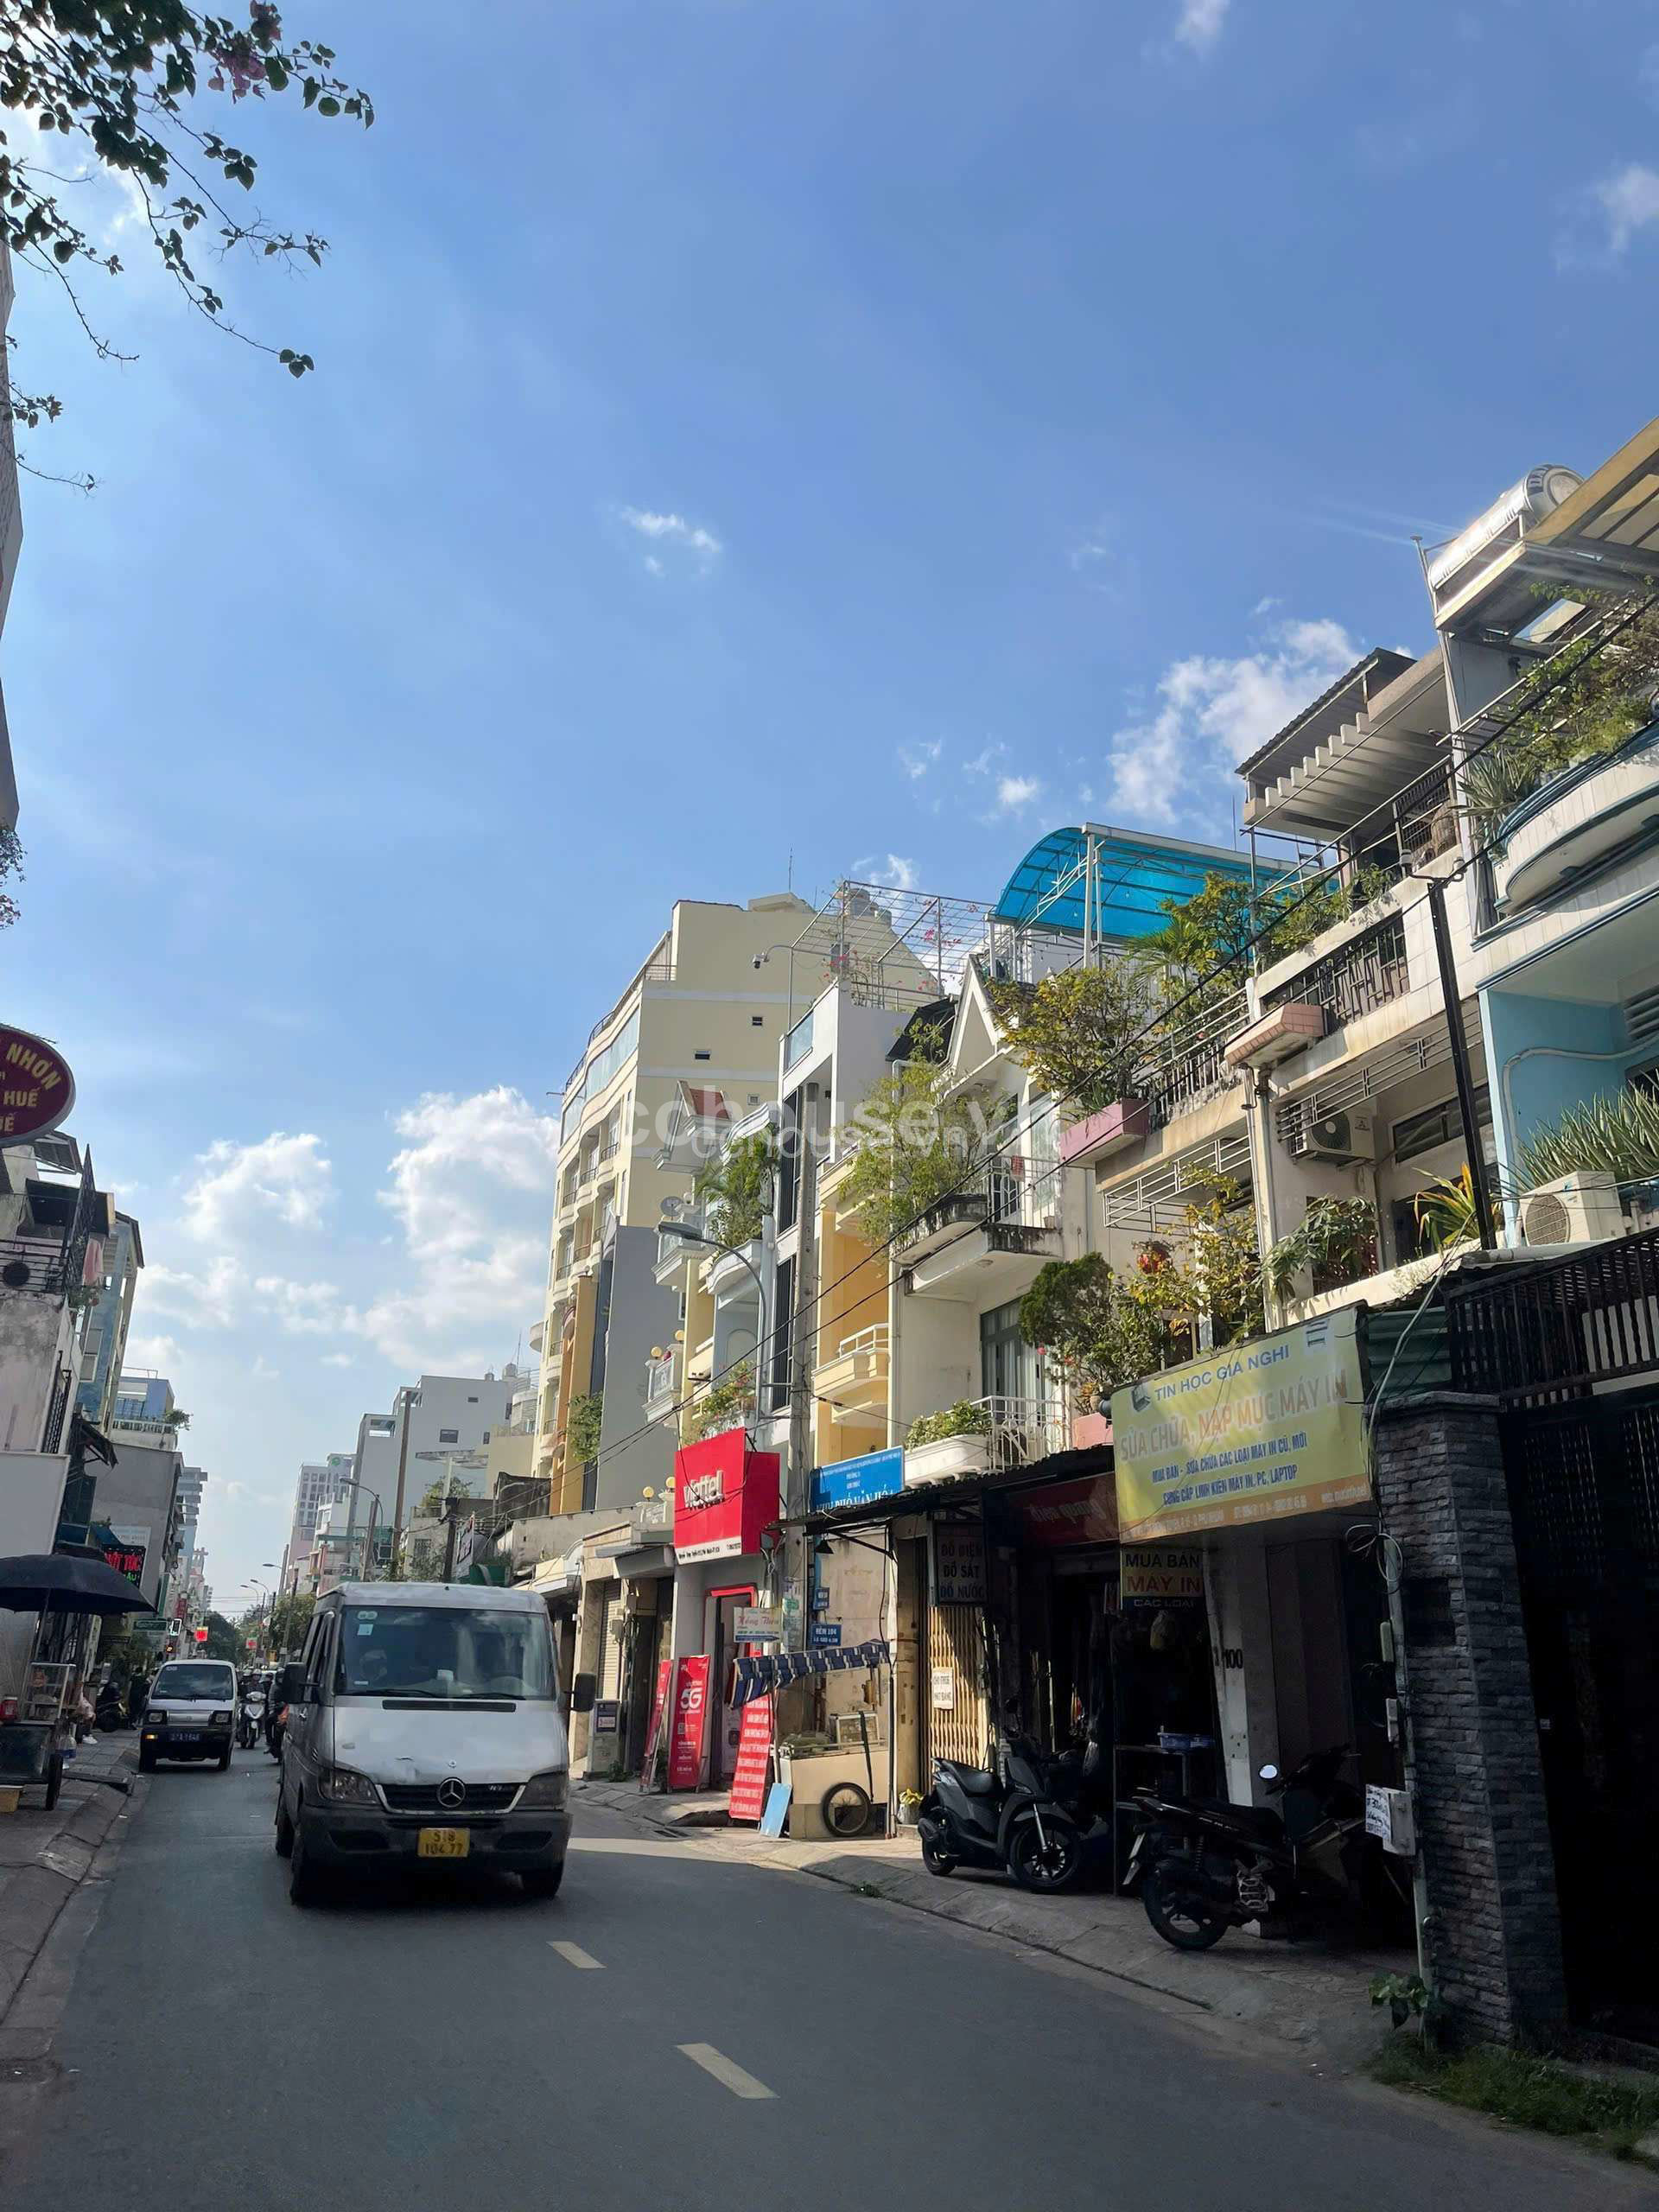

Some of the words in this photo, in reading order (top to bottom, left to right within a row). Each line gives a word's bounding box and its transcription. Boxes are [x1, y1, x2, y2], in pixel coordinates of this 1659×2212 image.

[6, 1042, 61, 1090] NHƠN
[3, 1086, 41, 1107] HUẾ
[1154, 1384, 1176, 1402] TIN
[1180, 1371, 1211, 1392] HỌC
[1217, 1361, 1244, 1381] GIA
[1248, 1344, 1290, 1370] NGHI
[1236, 1390, 1275, 1432] MỤC
[1280, 1376, 1319, 1418] MÁY
[1325, 1368, 1348, 1403] IN
[1271, 1465, 1298, 1485] LAPTOP
[1126, 1554, 1162, 1568] MUA
[1167, 1550, 1200, 1568] BÁN
[1127, 1572, 1173, 1592] MÁY
[1181, 1576, 1201, 1592] IN
[1224, 1649, 1243, 1669] 100
[680, 1687, 703, 1710] 5G
